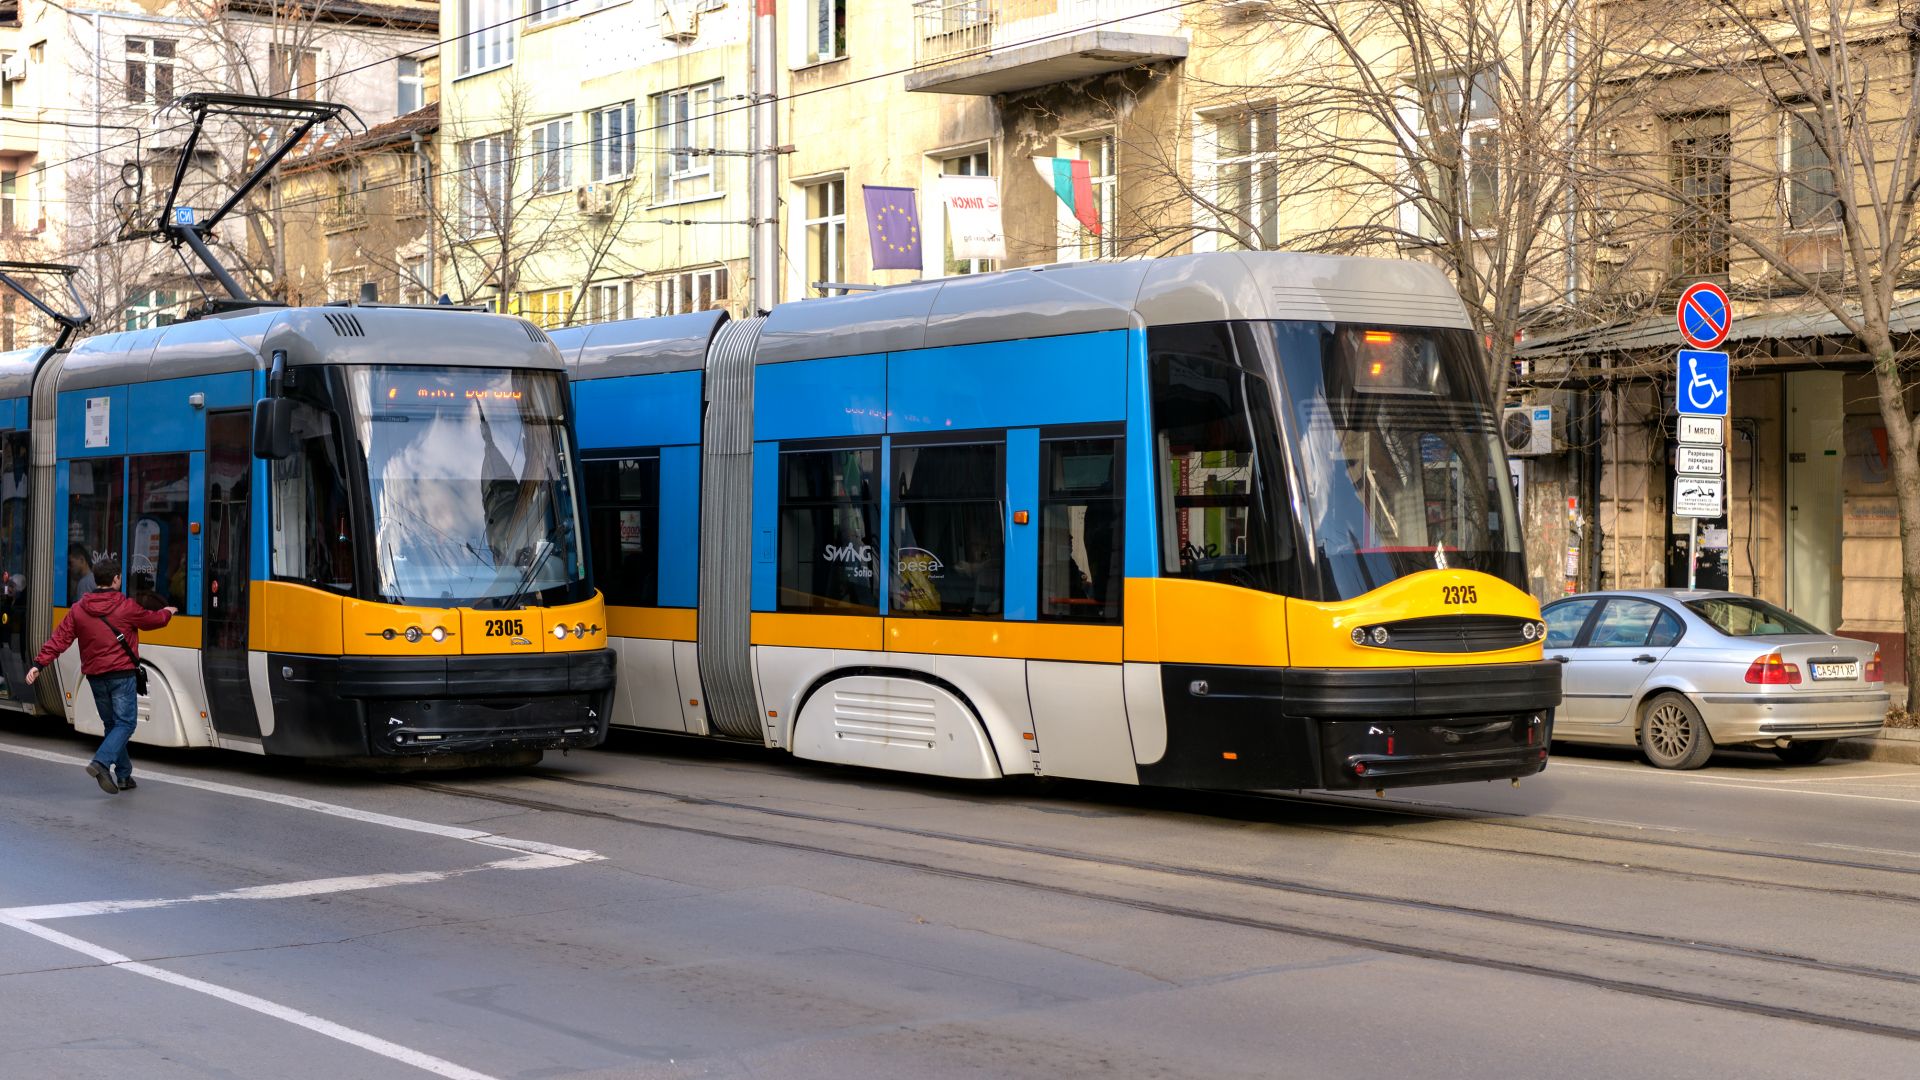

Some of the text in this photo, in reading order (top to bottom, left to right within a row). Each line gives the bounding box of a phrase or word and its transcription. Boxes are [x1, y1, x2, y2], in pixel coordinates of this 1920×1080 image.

[853, 566, 873, 578] Sofia
[898, 561, 938, 575] pesa
[1442, 585, 1478, 605] 2325
[485, 619, 524, 637] 2305
[1829, 664, 1845, 676] 5471
